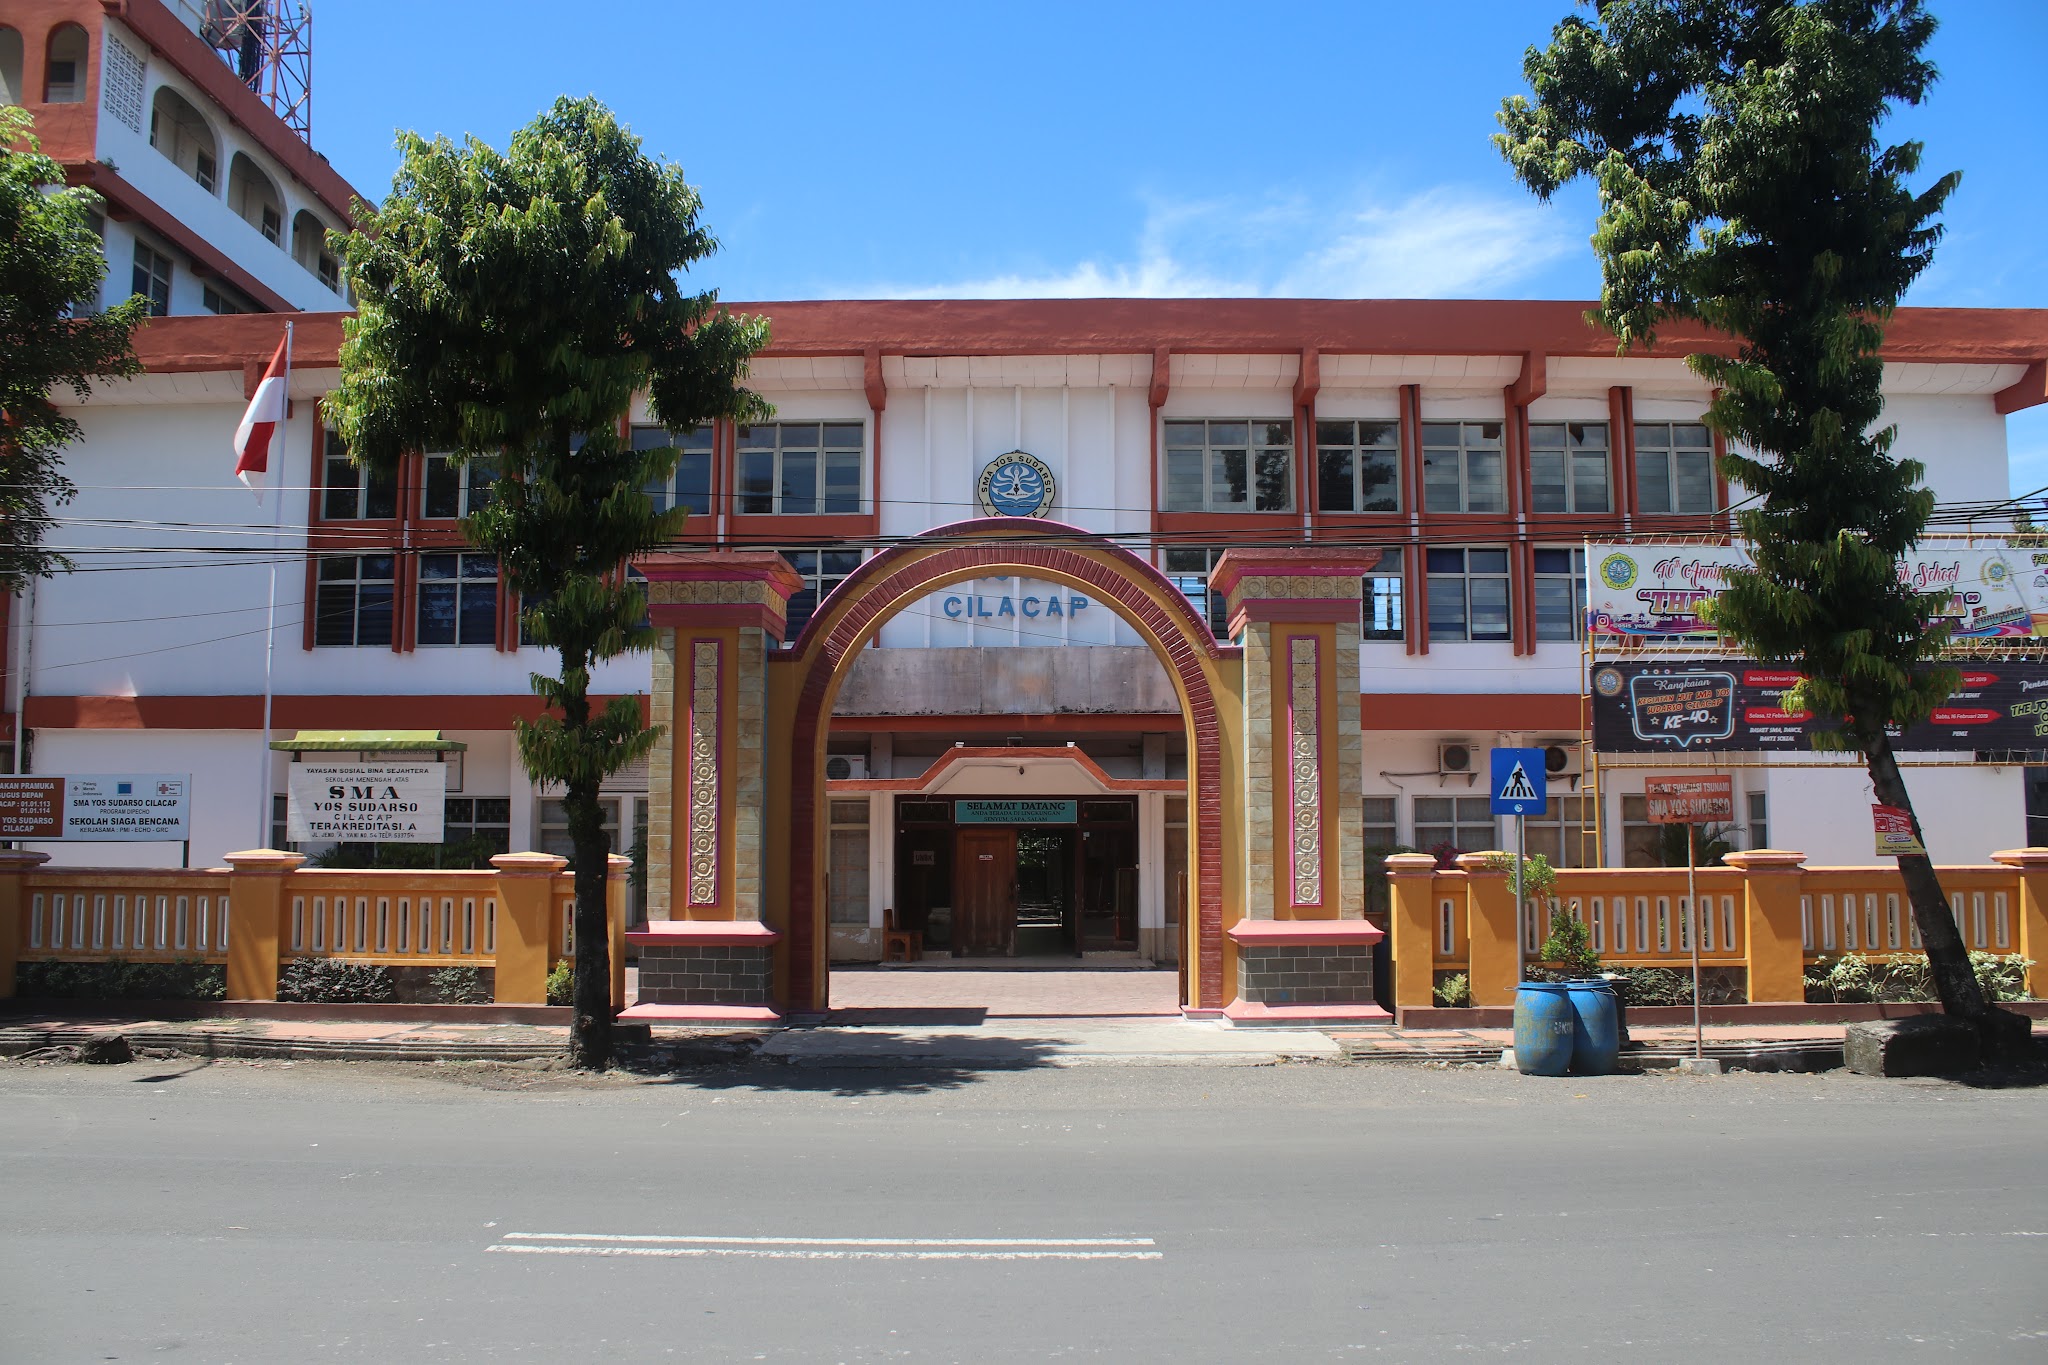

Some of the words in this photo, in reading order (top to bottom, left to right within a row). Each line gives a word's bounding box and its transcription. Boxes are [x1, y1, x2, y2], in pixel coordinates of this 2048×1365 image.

[982, 470, 994, 493] SMA
[994, 456, 1013, 468] YOS
[1018, 455, 1052, 493] SUDARSO
[1913, 562, 1961, 588] School
[944, 596, 1088, 618] CILACAP
[1654, 678, 1711, 692] Rangkaian
[1637, 695, 1674, 706] KEGIATAN
[1676, 692, 1693, 703] HUT
[1695, 690, 1712, 700] SMA
[1716, 688, 1730, 697] YOS
[1646, 704, 1683, 714] SUDARSO
[1686, 698, 1723, 710] CILACAP
[2011, 702, 2032, 717] THE
[1664, 709, 1709, 730] KE-40
[329, 786, 400, 800] SMA
[1703, 782, 1730, 792] TSUNAMI
[314, 802, 342, 812] YOS
[348, 802, 418, 812] SUDARSO
[967, 802, 1017, 810] SELAMAT
[1021, 802, 1066, 810] DATANG
[1649, 800, 1668, 816] SMA
[1670, 799, 1688, 816] YOS
